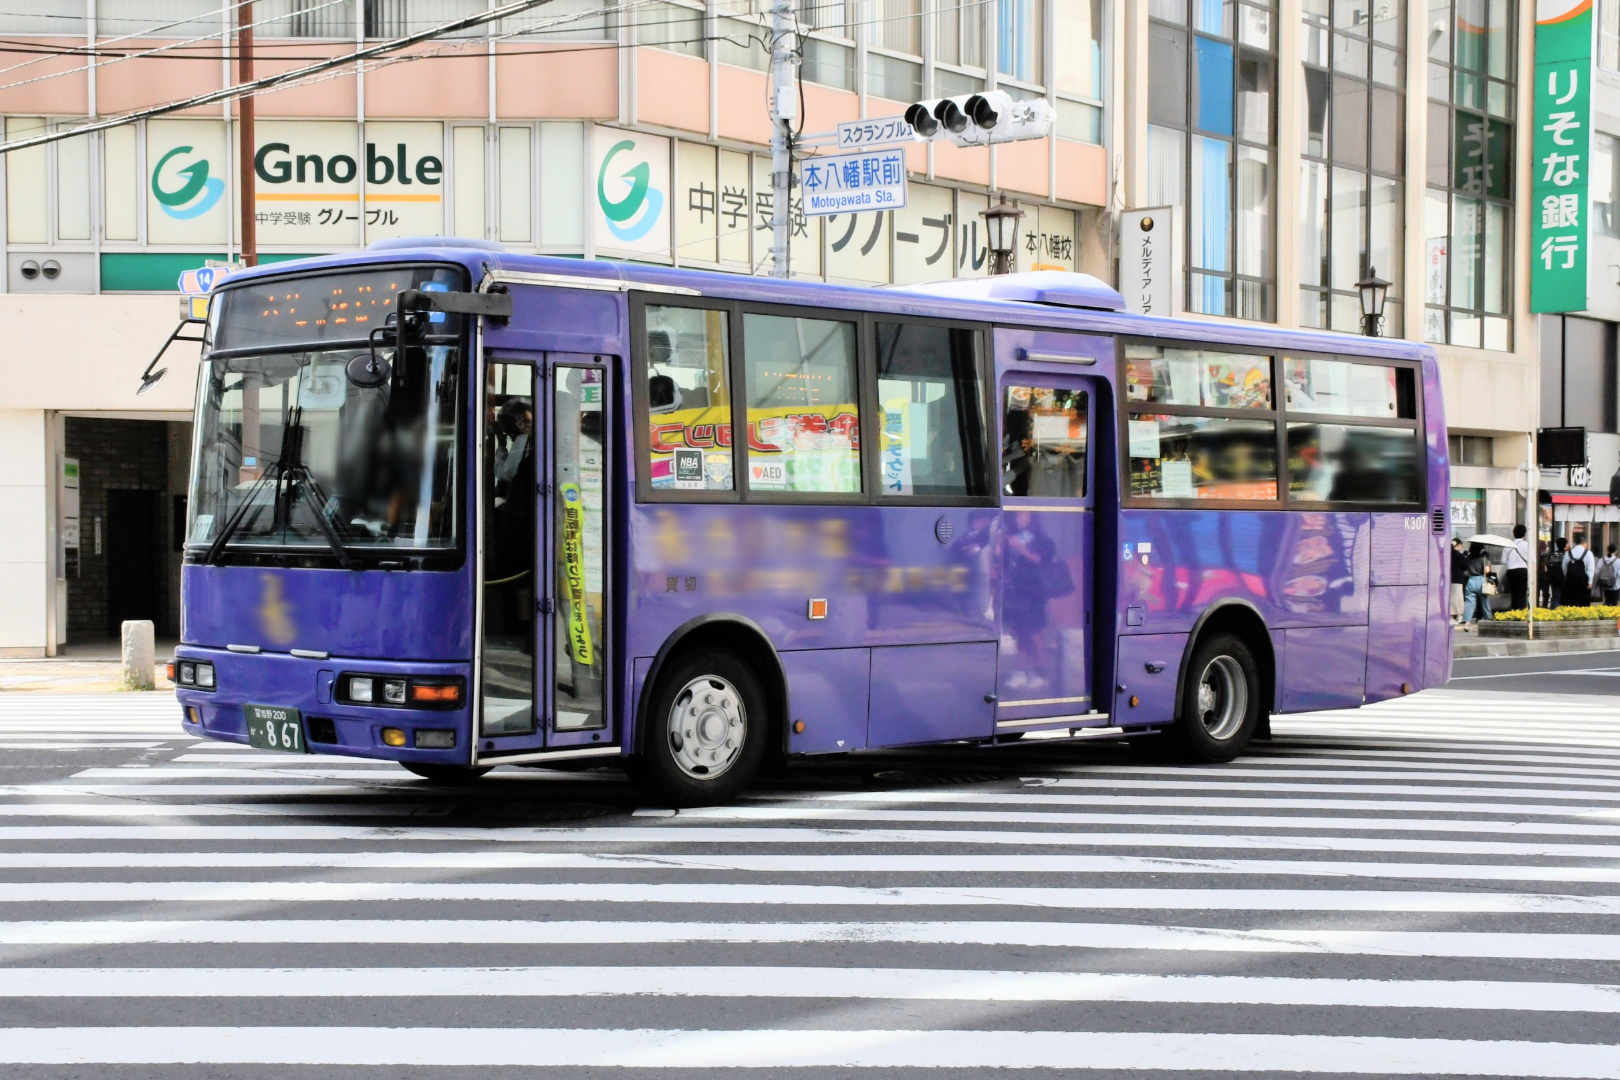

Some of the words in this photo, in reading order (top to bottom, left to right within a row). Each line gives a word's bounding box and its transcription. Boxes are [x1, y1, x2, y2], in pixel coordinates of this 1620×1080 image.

[254, 142, 443, 185] Gnoble
[1541, 69, 1580, 270] りそな銀行
[804, 156, 901, 192] 本八幡駅前
[811, 192, 871, 209] Motoyawata
[875, 189, 896, 203] Sta.
[255, 210, 311, 226] 中学受験
[317, 208, 399, 226] グノーブル
[1025, 229, 1072, 261] 本八幡校
[1141, 236, 1152, 290] メルディア
[199, 273, 211, 285] 14
[680, 457, 699, 467] NBA
[762, 466, 782, 479] AED
[1404, 516, 1427, 530] K307
[665, 575, 697, 593] 貸切
